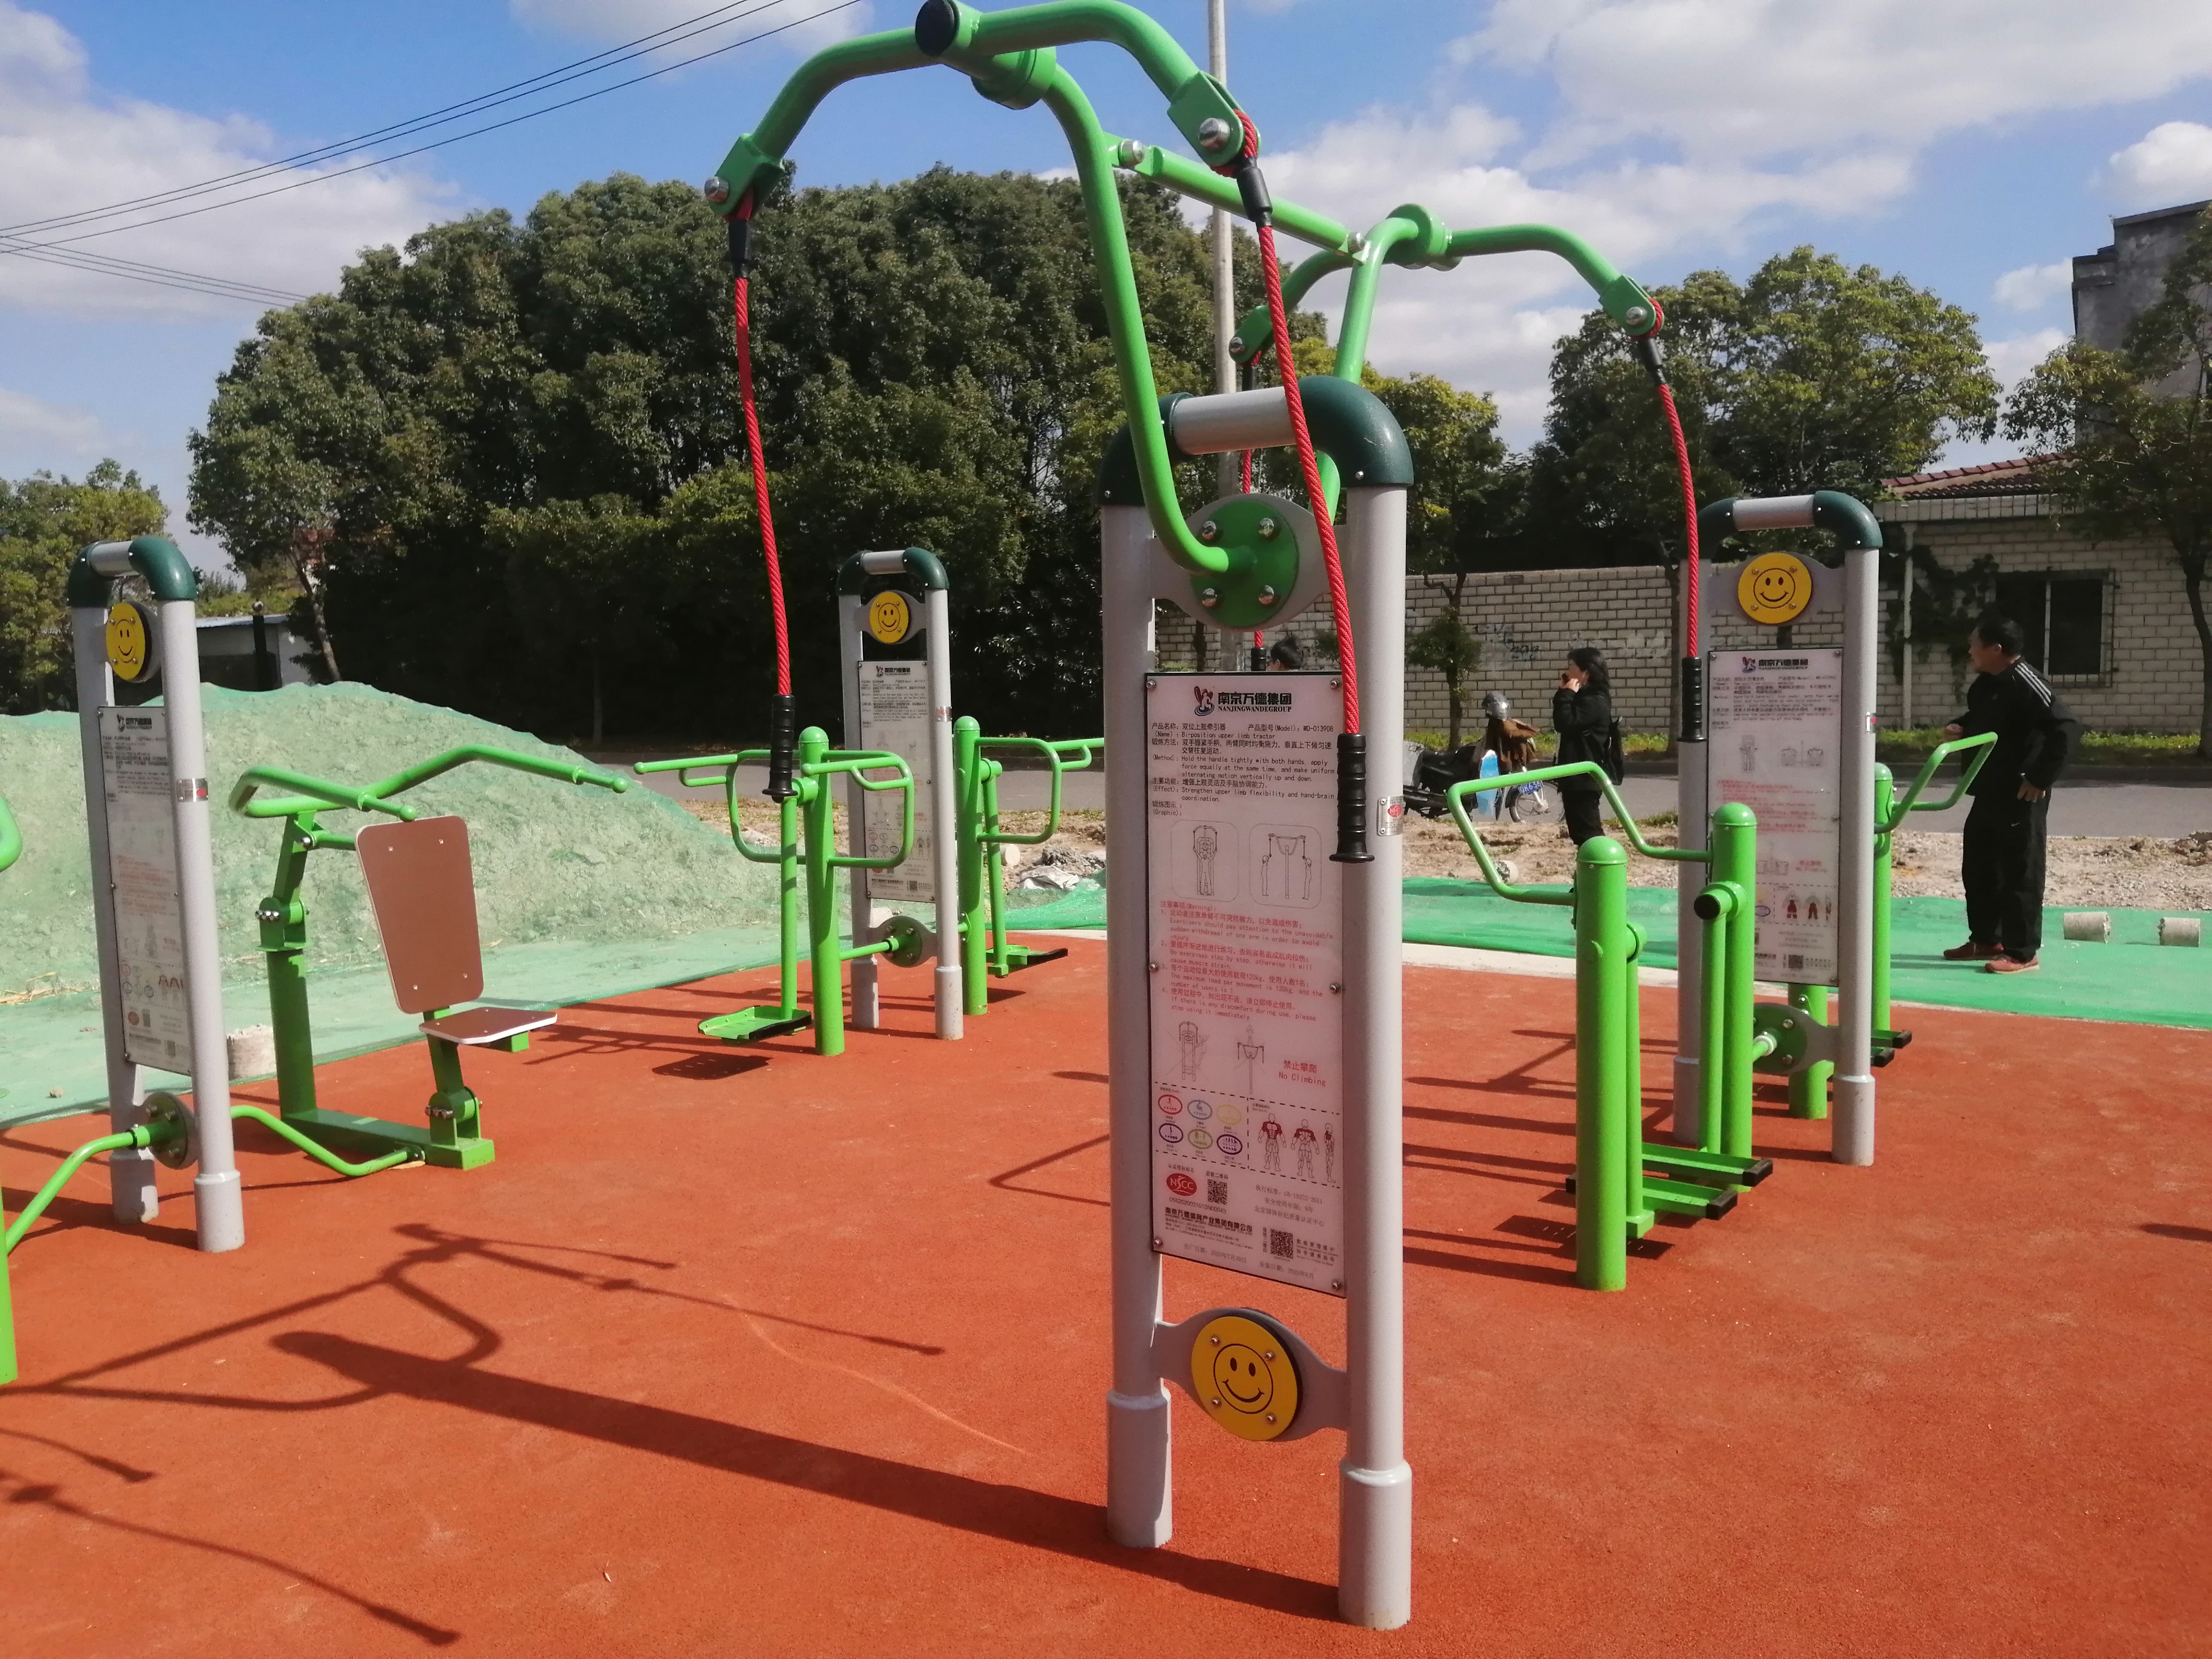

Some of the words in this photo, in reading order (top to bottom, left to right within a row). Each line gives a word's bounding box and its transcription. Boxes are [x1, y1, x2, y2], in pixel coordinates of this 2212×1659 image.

[1217, 691, 1292, 705] 南京万德集团
[1249, 789, 1284, 798] flexibility
[1191, 928, 1223, 936] withdrawal
[1255, 959, 1285, 967] otherwise
[1255, 1007, 1275, 1016] during
[1283, 1060, 1317, 1074] 禁止攀爬
[1279, 1071, 1287, 1079] No
[1291, 1073, 1325, 1086] Climbing
[1170, 1174, 1193, 1192] NSCC
